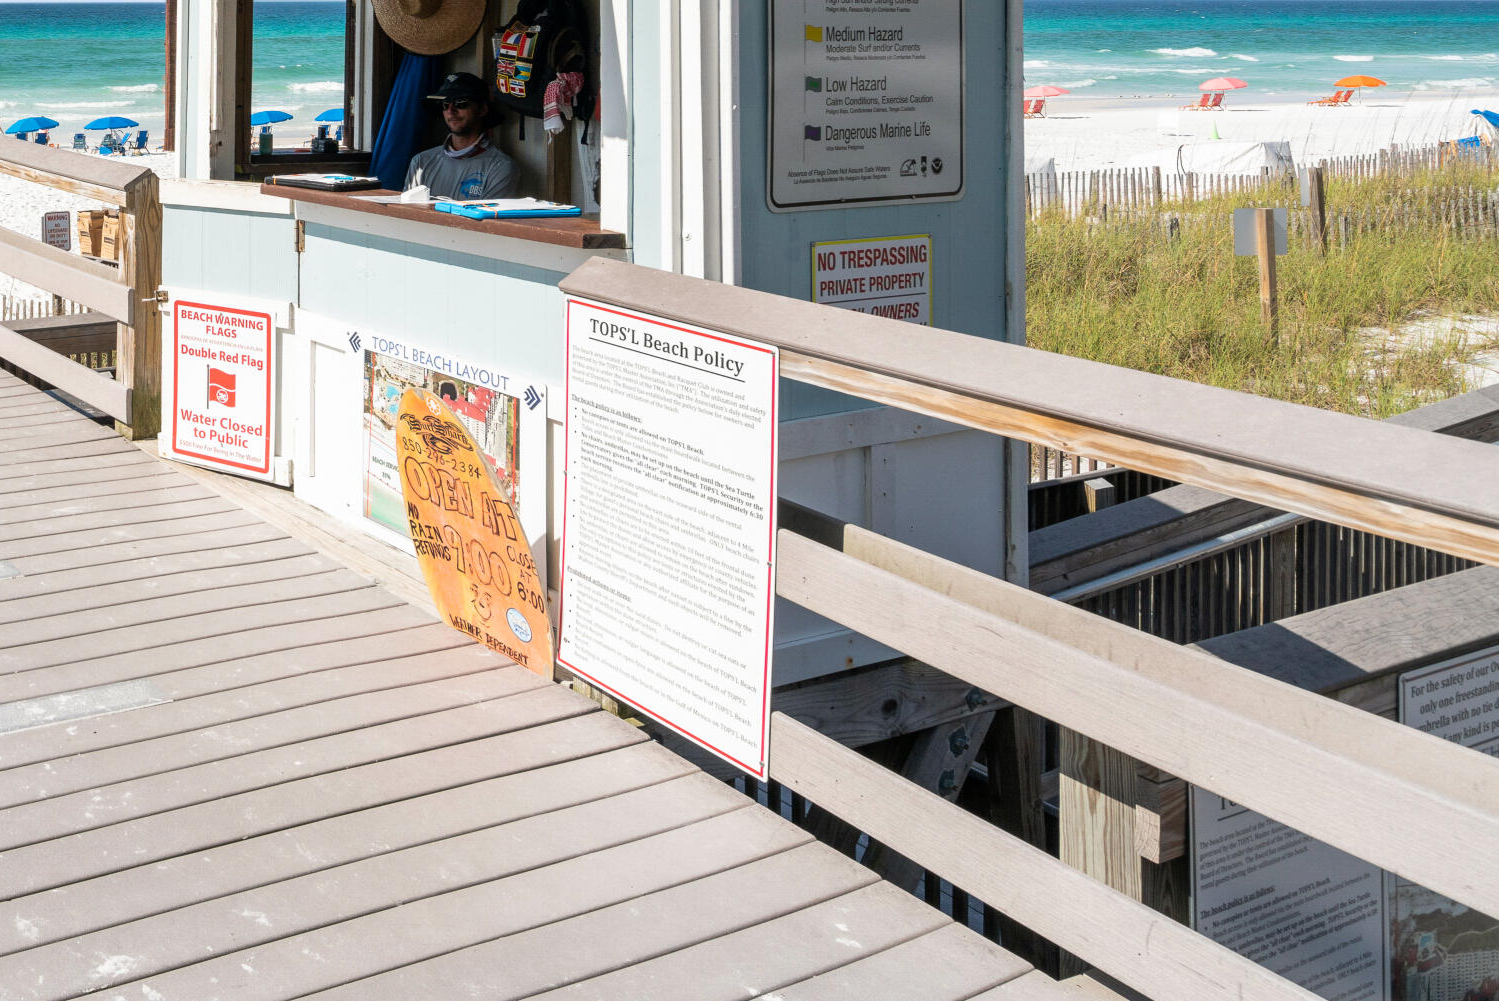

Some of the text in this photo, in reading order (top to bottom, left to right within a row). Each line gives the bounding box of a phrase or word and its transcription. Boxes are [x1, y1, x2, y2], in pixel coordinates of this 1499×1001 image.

[826, 26, 902, 41] Medium Hazard
[826, 44, 856, 52] Moderate
[858, 43, 871, 52] Surf
[894, 43, 920, 51] Currents
[826, 75, 886, 92] Low Hazard
[825, 97, 842, 105] Calm
[881, 95, 908, 104] Exercise
[909, 94, 933, 103] Caution
[825, 120, 930, 144] Dangerous Marine Life
[469, 185, 482, 195] DBS
[818, 244, 927, 271] NO TRESPASSING
[820, 272, 925, 296] PRIVATE PROPERTY
[181, 309, 263, 331] BEACH WARNING
[205, 324, 237, 338] FLAGS
[180, 343, 263, 370] Double Red Flag
[590, 318, 744, 377] TOPS'L Beach Policy
[372, 336, 509, 390] TOPS'L BEACH LAYOUT
[180, 408, 262, 437] Water Closed
[193, 427, 248, 449] to Public
[683, 468, 699, 480] beach
[700, 474, 713, 485] until
[714, 479, 723, 489] the
[725, 483, 735, 493] Sea
[736, 487, 754, 500] Turtle
[405, 456, 517, 541] OPEN AT
[706, 493, 747, 516] approximately
[720, 490, 744, 506] Security
[753, 502, 763, 513] the
[408, 501, 419, 520] NO
[410, 520, 443, 543] RAIN
[413, 539, 451, 561] REFUNDS
[449, 613, 482, 640] WEATHER
[1411, 686, 1424, 697] For
[1426, 681, 1439, 693] the
[1441, 673, 1466, 687] safety
[1466, 668, 1474, 680] of
[1475, 666, 1489, 677] our
[1420, 680, 1499, 714] only one freestandin
[1420, 716, 1450, 732] mbrella
[1451, 708, 1469, 723] with
[1471, 706, 1481, 717] no
[1482, 702, 1492, 713] tie
[1463, 723, 1482, 739] kind
[1484, 721, 1490, 732] is
